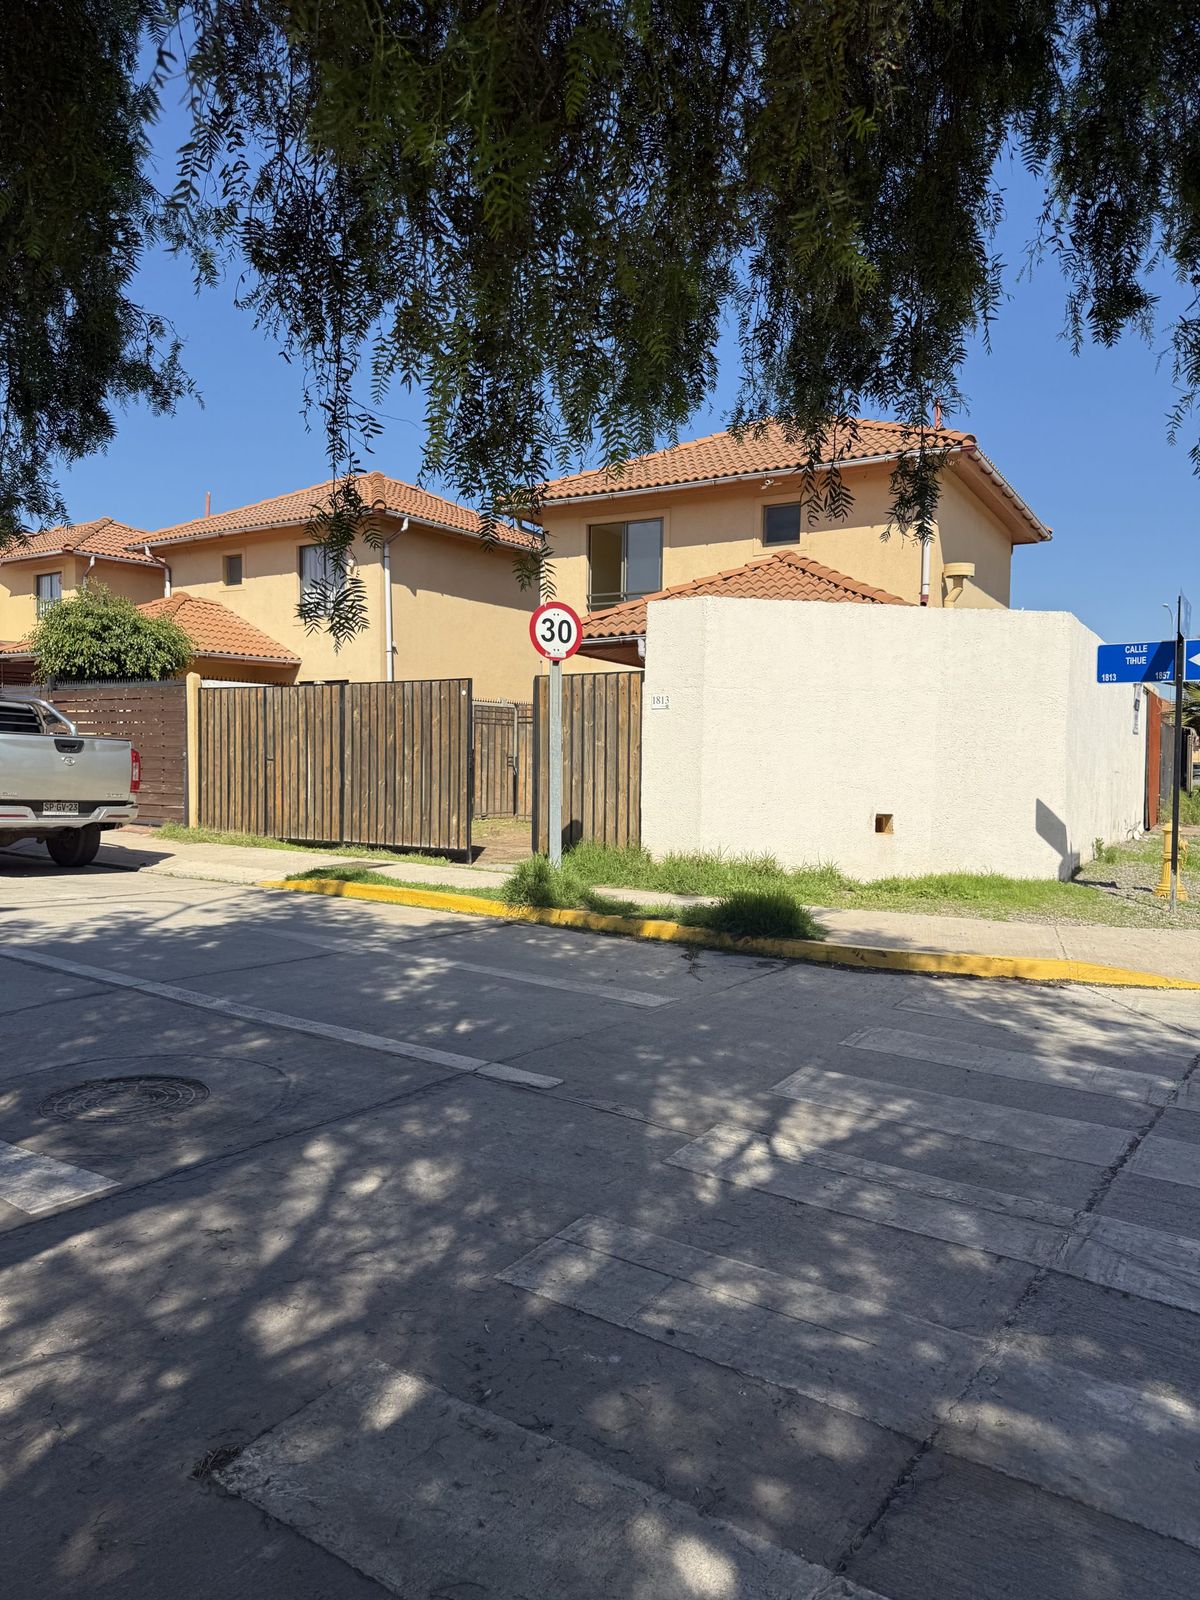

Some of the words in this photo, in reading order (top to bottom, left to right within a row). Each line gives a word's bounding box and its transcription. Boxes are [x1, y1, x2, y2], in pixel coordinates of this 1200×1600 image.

[541, 618, 572, 644] 30
[1125, 645, 1148, 654] CALLE
[1125, 656, 1147, 665] TIHUE
[1101, 673, 1117, 682] 1813
[652, 696, 670, 705] 1813
